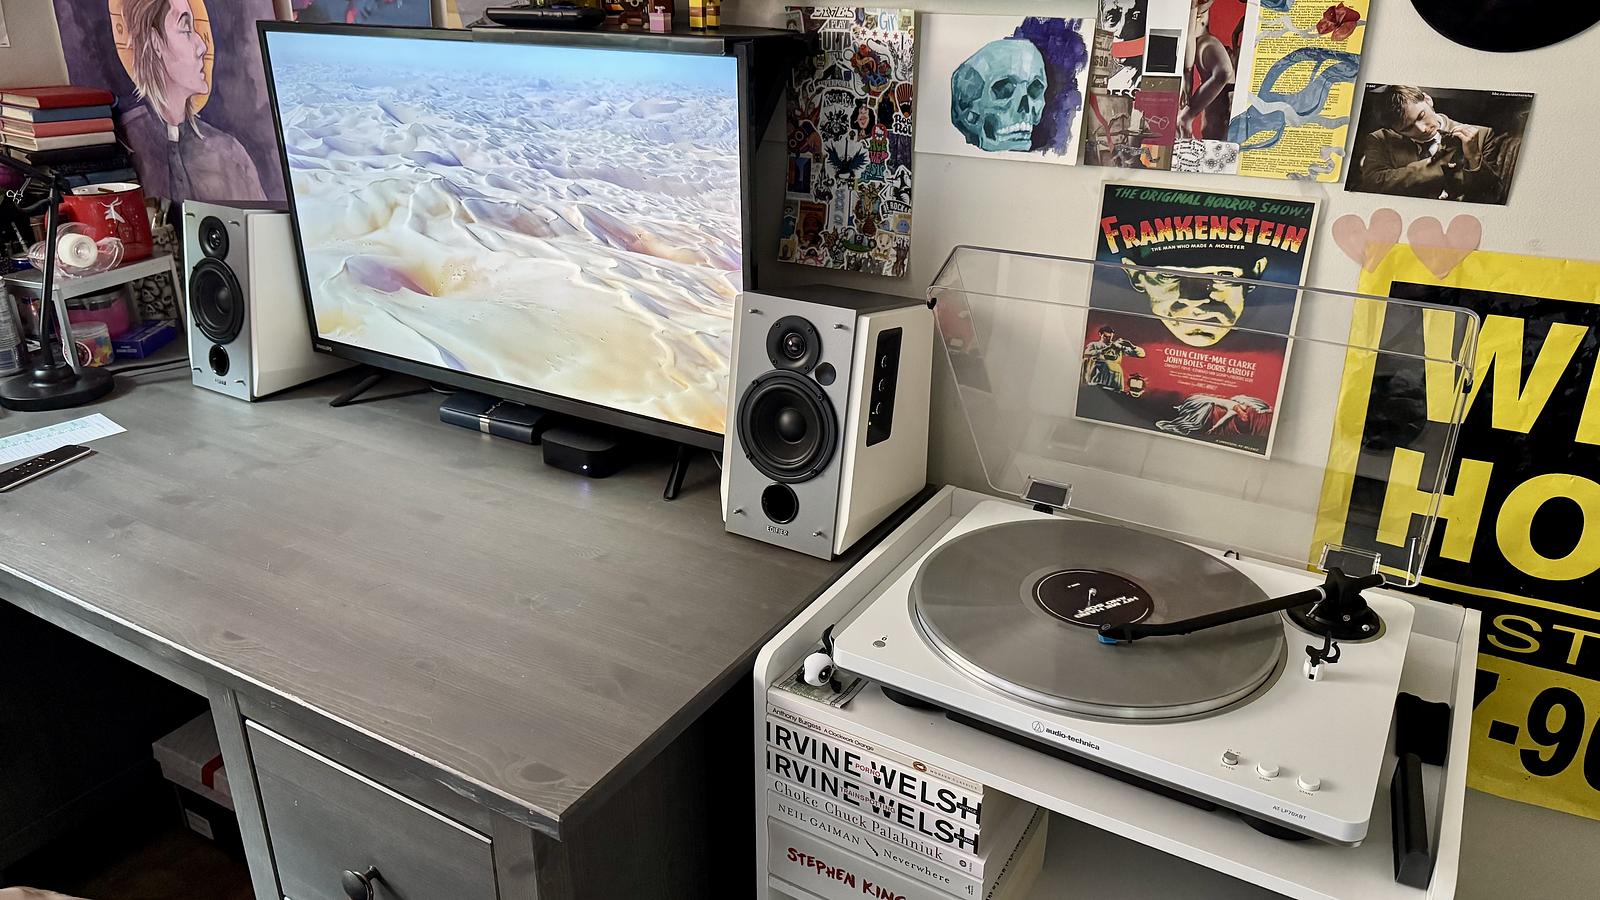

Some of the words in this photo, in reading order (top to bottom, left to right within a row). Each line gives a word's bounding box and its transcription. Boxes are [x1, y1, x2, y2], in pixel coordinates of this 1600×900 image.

[1115, 188, 1138, 200] THE
[1140, 190, 1201, 206] ORIGINAL
[1203, 195, 1257, 212] HORROR
[1260, 202, 1312, 218] SHOW!
[1100, 215, 1308, 254] FRANKENSTEIN
[1214, 243, 1246, 251] MONSTER
[1164, 347, 1188, 358] COLIN
[1228, 358, 1257, 371] CLARKE
[1164, 356, 1183, 365] JOHN
[1206, 362, 1226, 373] BORIS
[772, 708, 797, 722] Anthony
[798, 717, 822, 731] Burgess
[828, 730, 854, 743] Clockwork
[854, 739, 875, 751] Orange
[1045, 728, 1100, 750] audio-technica
[766, 721, 861, 778] IRVINE
[870, 760, 982, 825] WELSH
[855, 763, 881, 777] PORNO
[766, 751, 860, 806] IRVINE
[869, 790, 980, 855] WELSH
[840, 787, 895, 814] TRAINSPOTTING
[774, 780, 818, 808] Choke
[825, 801, 867, 829] Chuck
[871, 820, 943, 861] Palahniuk
[778, 803, 807, 822] NEIL
[810, 817, 861, 845] GAIMAN
[883, 849, 950, 884] Neverwhere
[787, 847, 856, 889] STEPHEN
